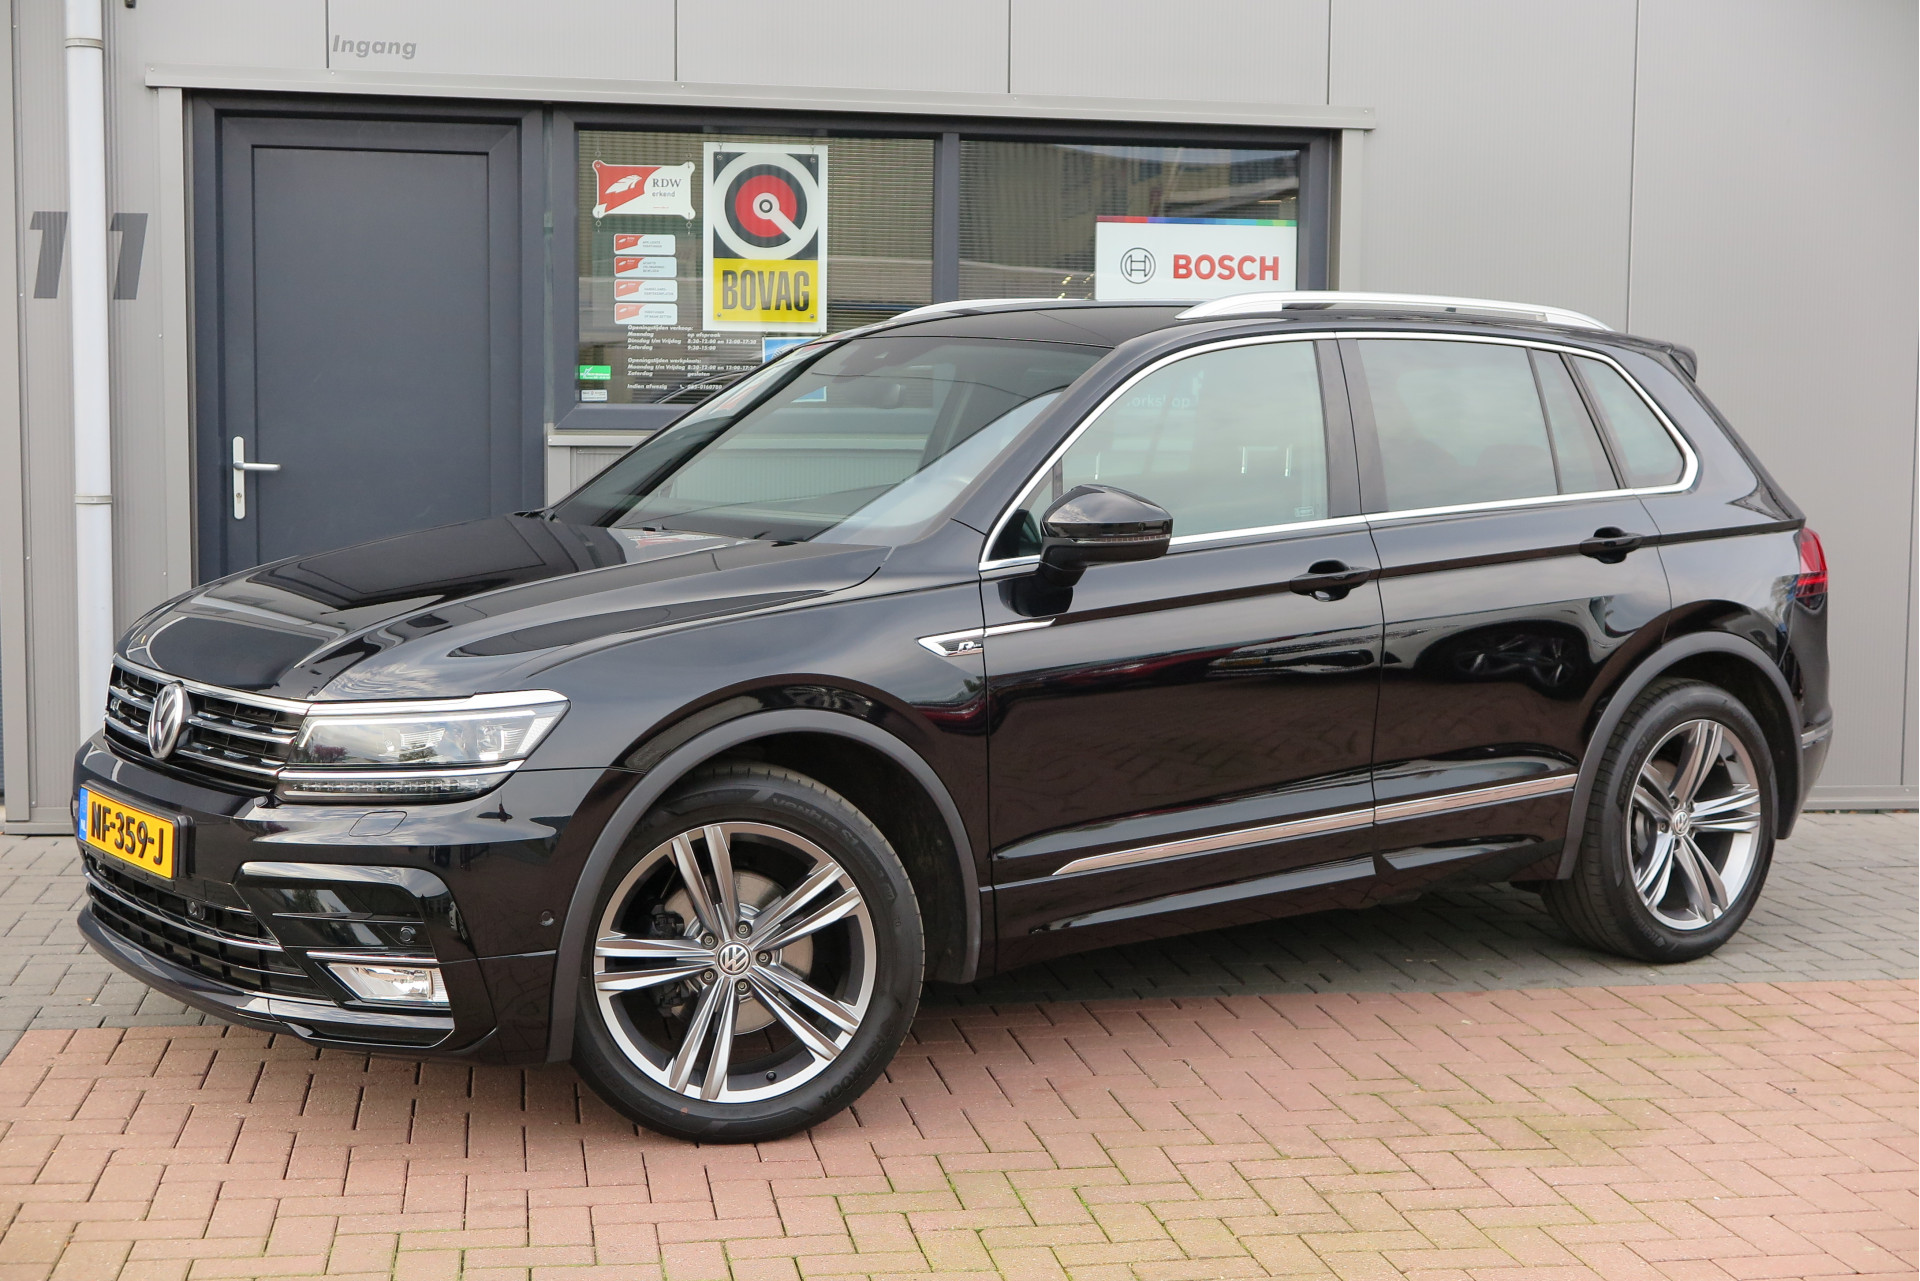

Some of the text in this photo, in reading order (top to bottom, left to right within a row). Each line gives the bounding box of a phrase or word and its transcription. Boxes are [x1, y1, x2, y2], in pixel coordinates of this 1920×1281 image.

[333, 35, 417, 60] Ingang
[652, 178, 682, 188] RDW
[1172, 253, 1280, 281] BOSCH
[722, 269, 810, 312] BOVAG
[627, 324, 669, 332] Openingstijden
[91, 801, 164, 866] NF-359-J
